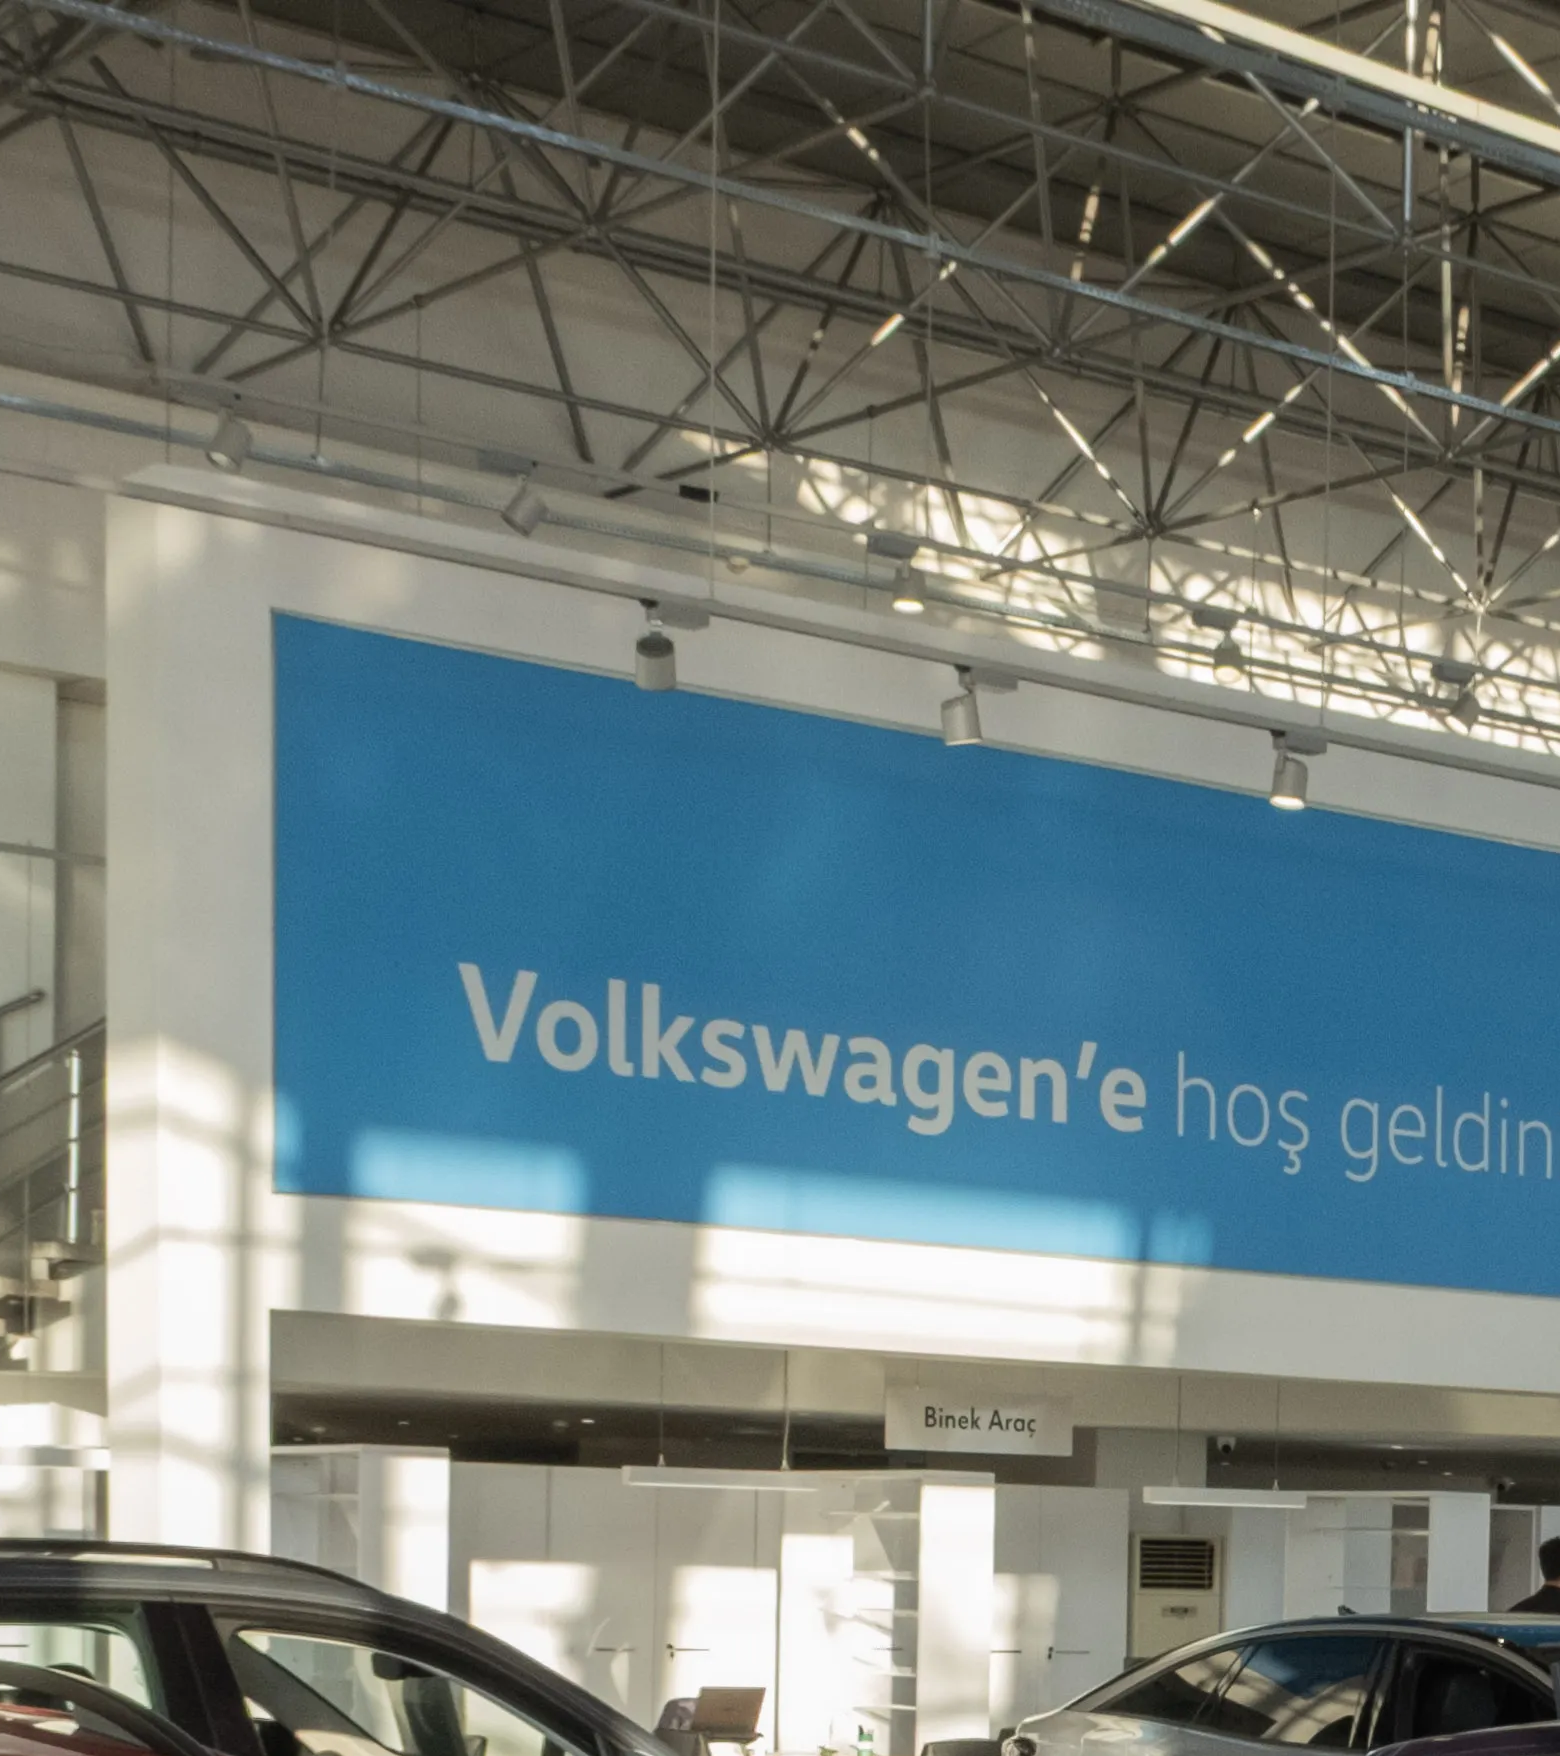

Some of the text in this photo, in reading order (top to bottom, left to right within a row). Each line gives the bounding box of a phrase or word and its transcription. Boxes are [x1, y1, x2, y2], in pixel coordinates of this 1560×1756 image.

[1176, 1050, 1310, 1175] hoş
[924, 1406, 1037, 1438] Binek Araç
